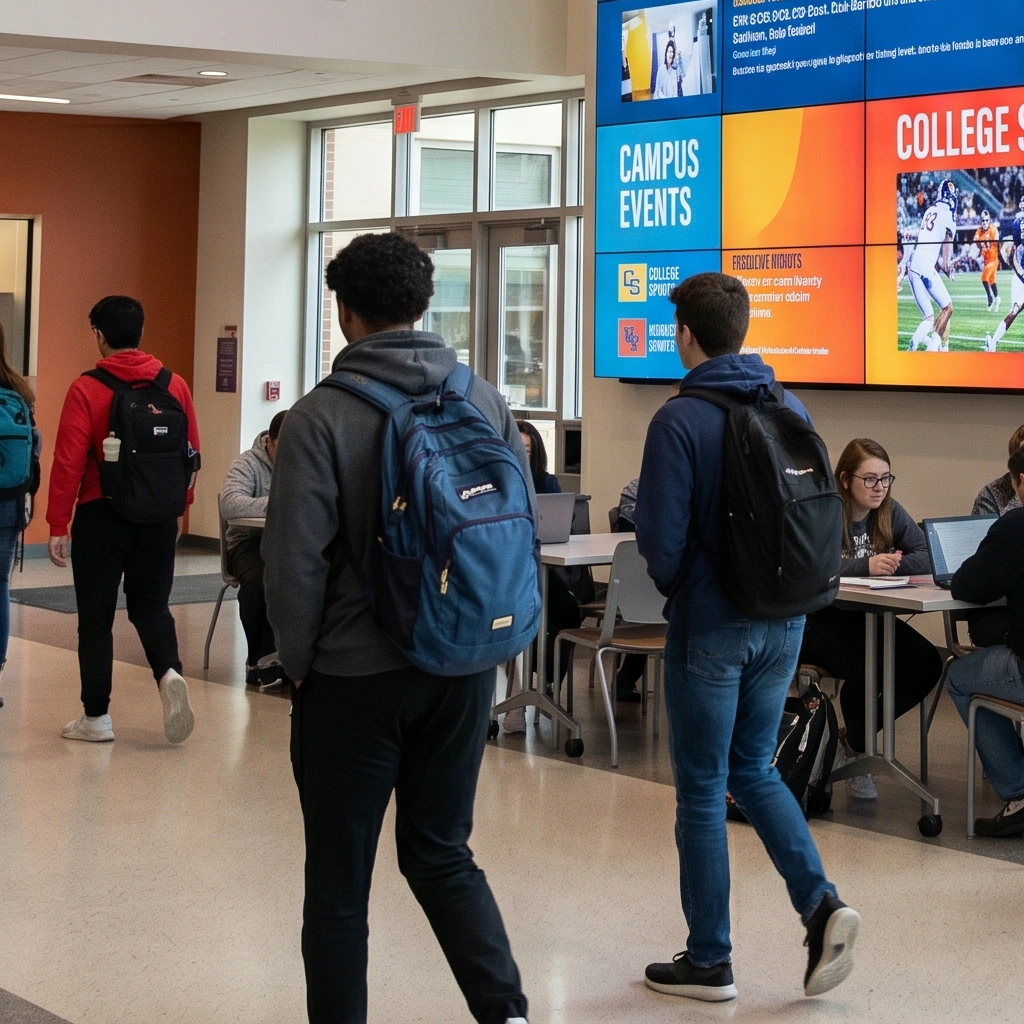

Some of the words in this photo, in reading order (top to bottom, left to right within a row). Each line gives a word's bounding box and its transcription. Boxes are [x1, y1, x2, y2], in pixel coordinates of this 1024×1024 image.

[896, 105, 1010, 160] COLLEGE
[619, 138, 700, 183] CAMPUS
[619, 185, 692, 229] EVENTS
